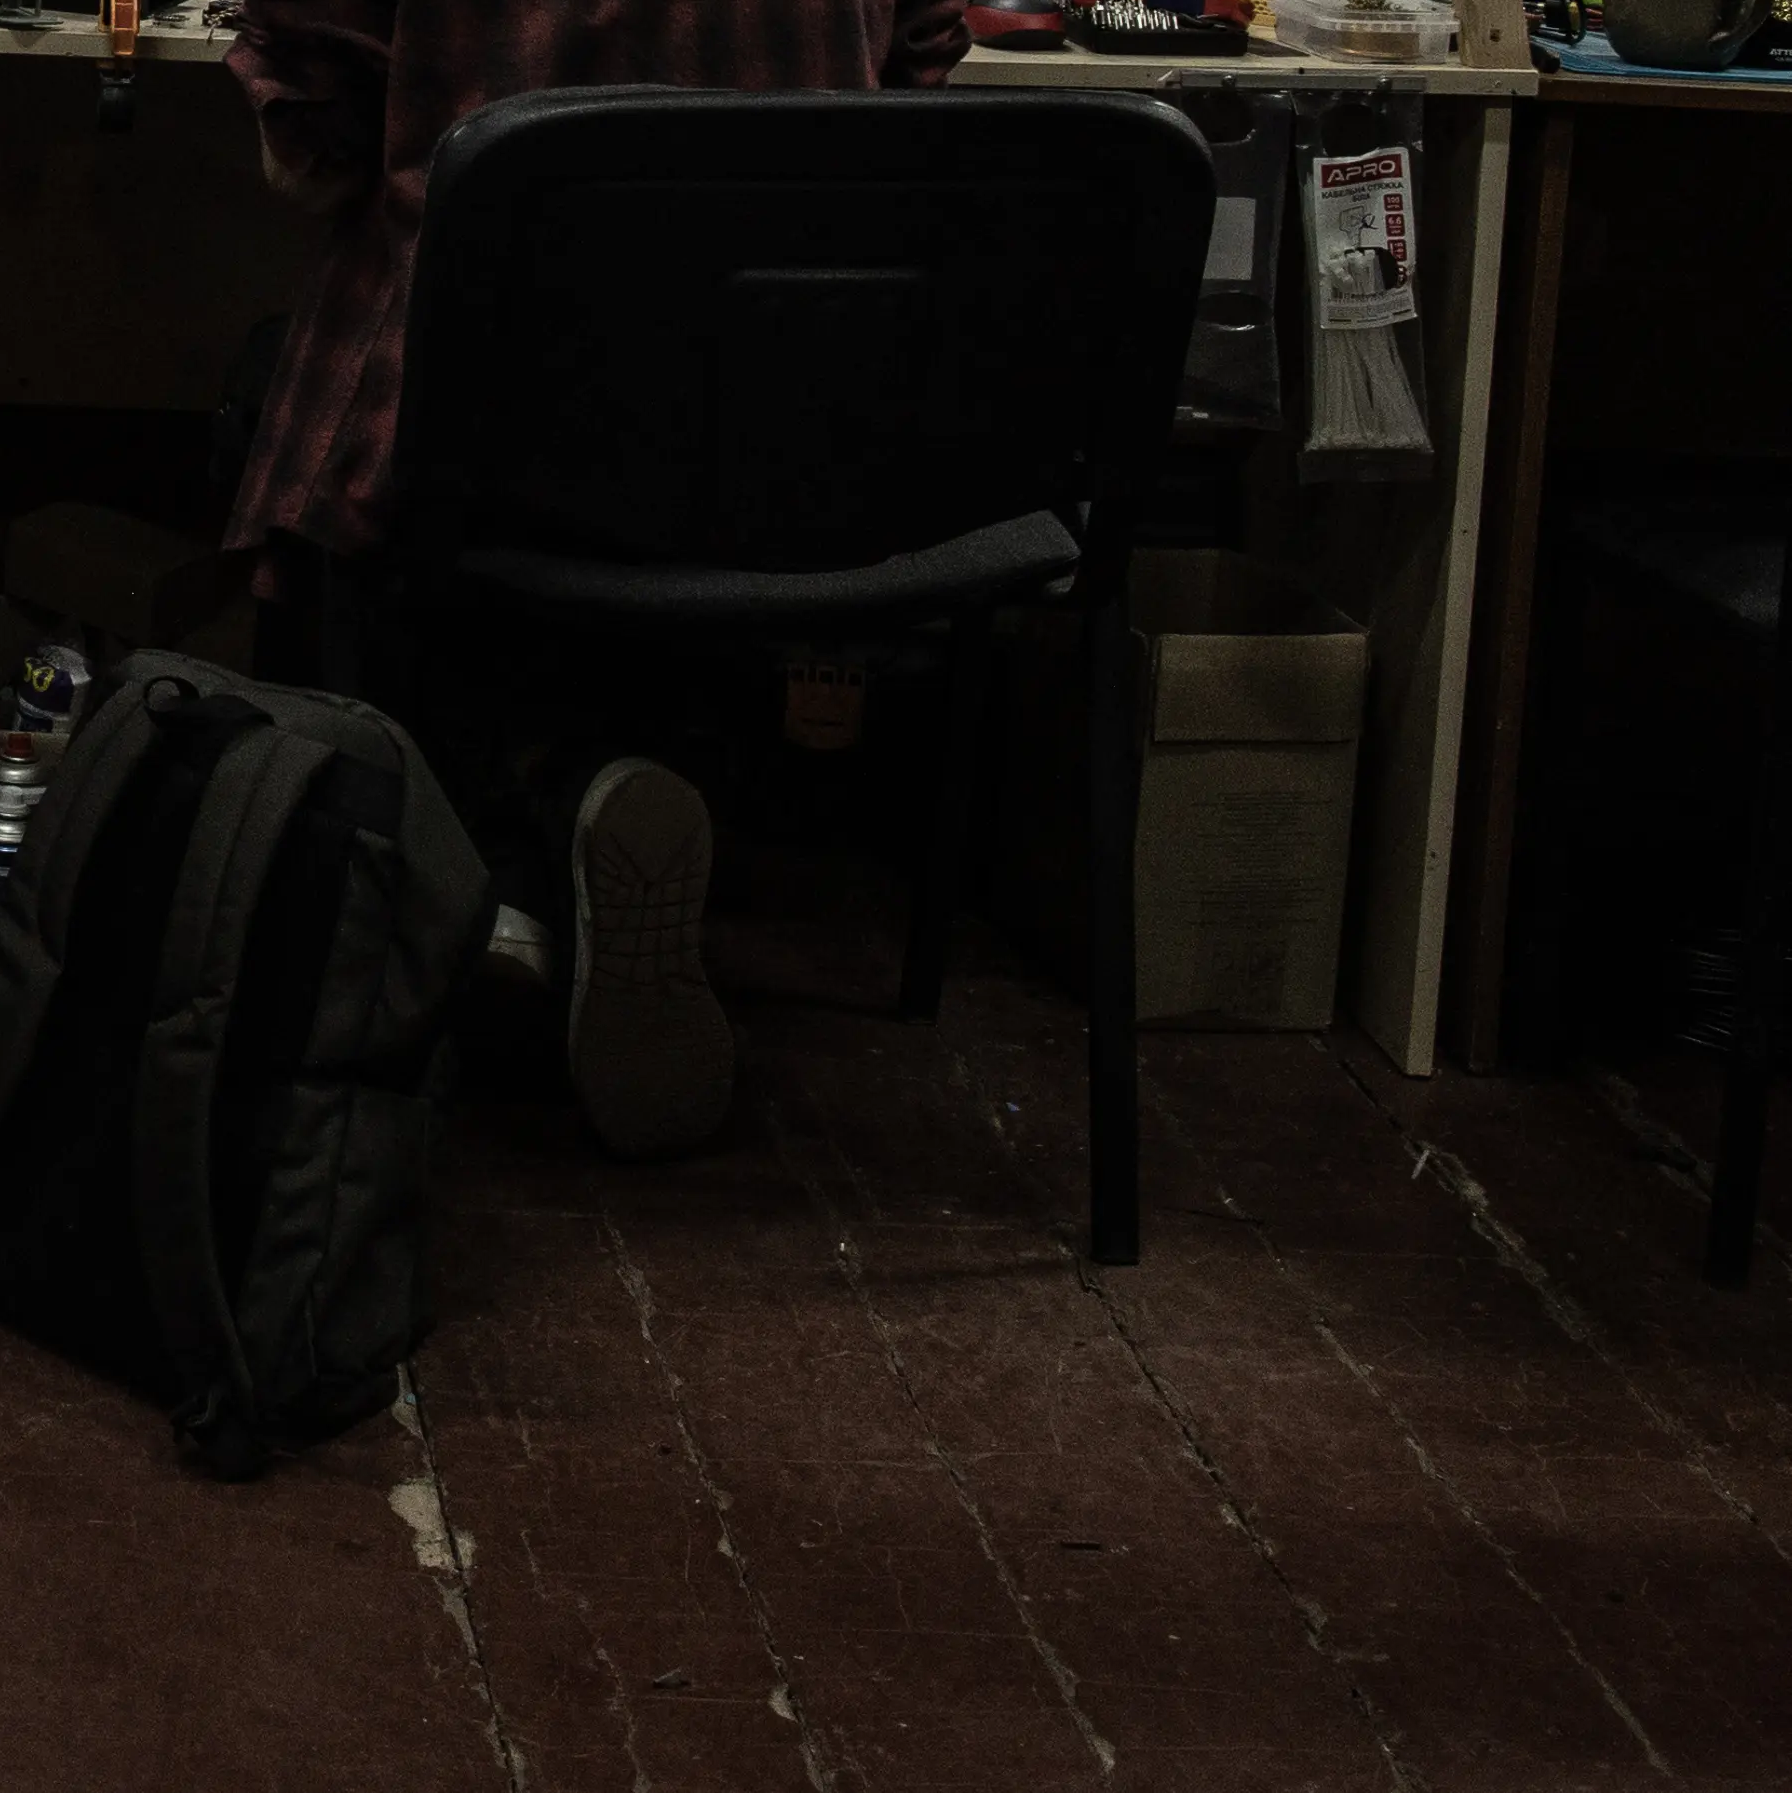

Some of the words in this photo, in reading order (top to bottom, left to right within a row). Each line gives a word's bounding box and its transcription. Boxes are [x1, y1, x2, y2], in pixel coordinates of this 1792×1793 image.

[1326, 159, 1396, 184] APRO
[1321, 186, 1366, 199] КАБЕЛЬНА
[1367, 181, 1404, 192] СТЯЖКА
